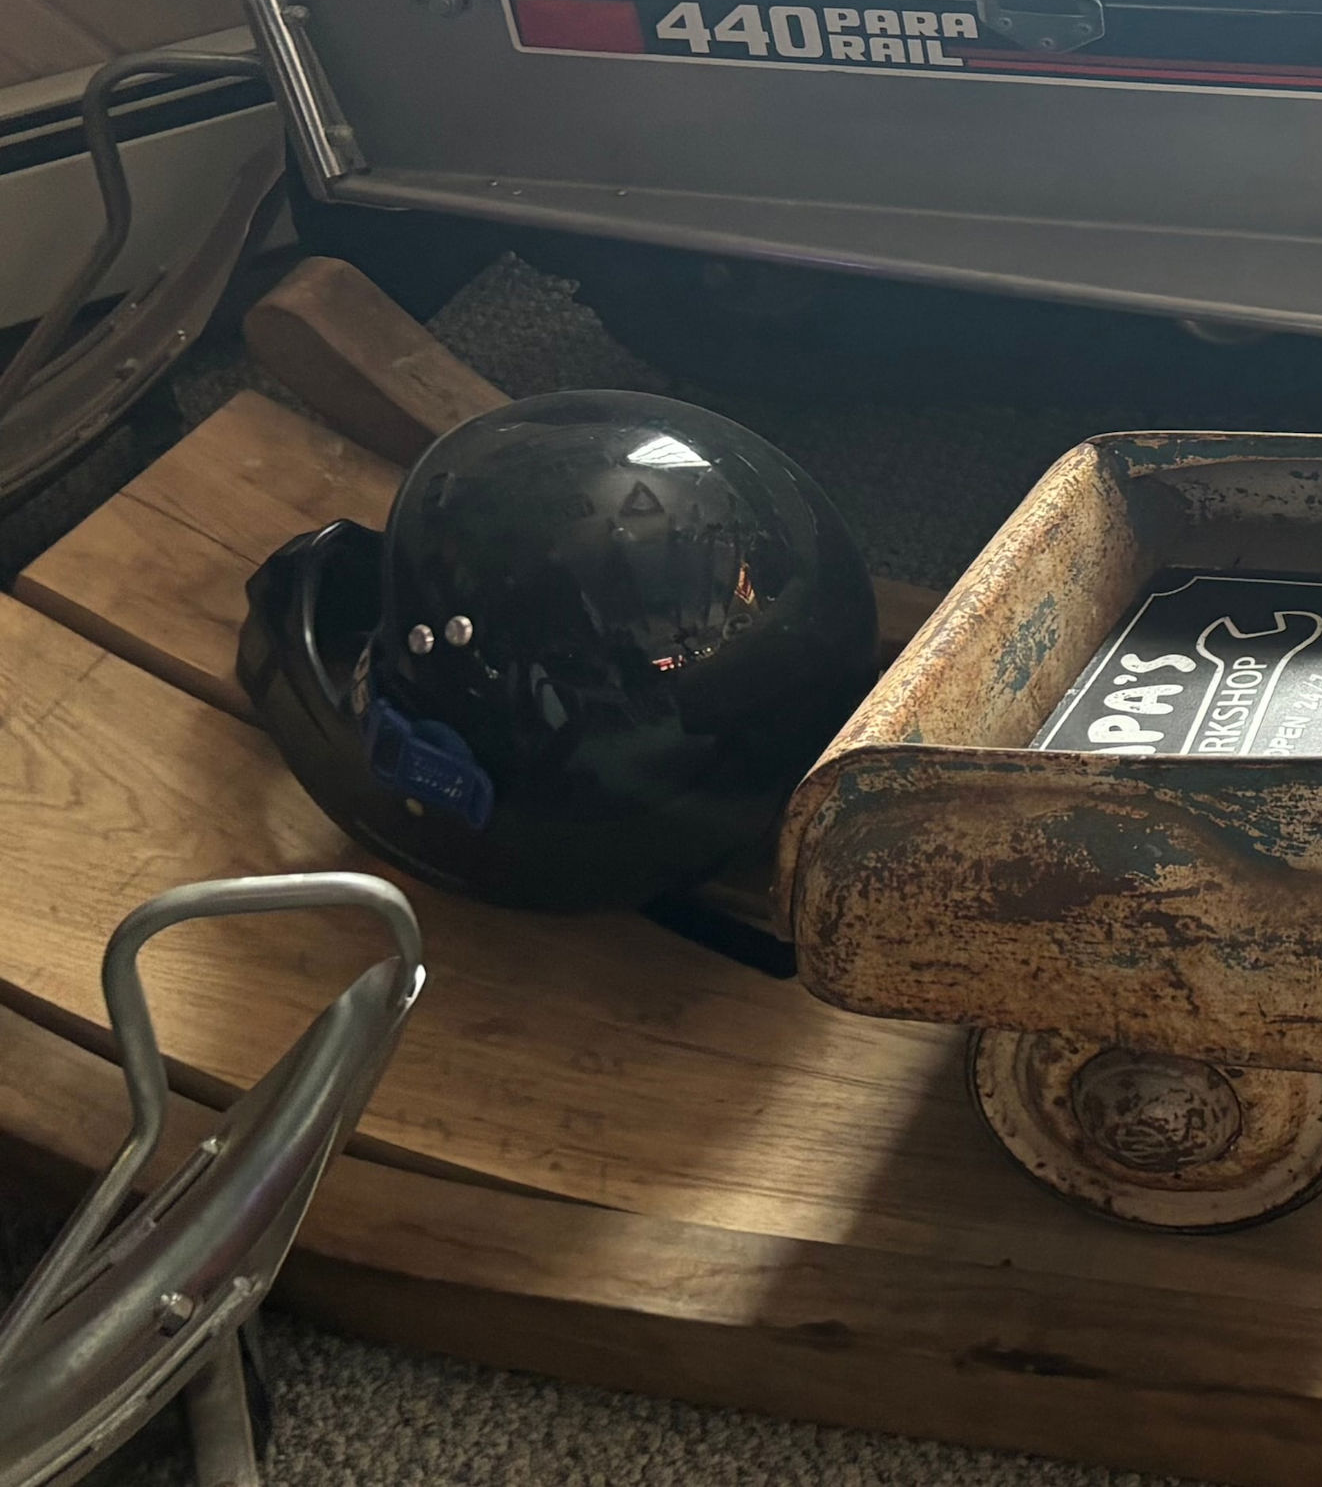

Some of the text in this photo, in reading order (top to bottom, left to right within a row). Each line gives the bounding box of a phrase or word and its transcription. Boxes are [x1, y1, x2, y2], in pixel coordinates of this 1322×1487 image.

[656, 2, 979, 59] 440 PARA
[827, 34, 965, 67] RAIL
